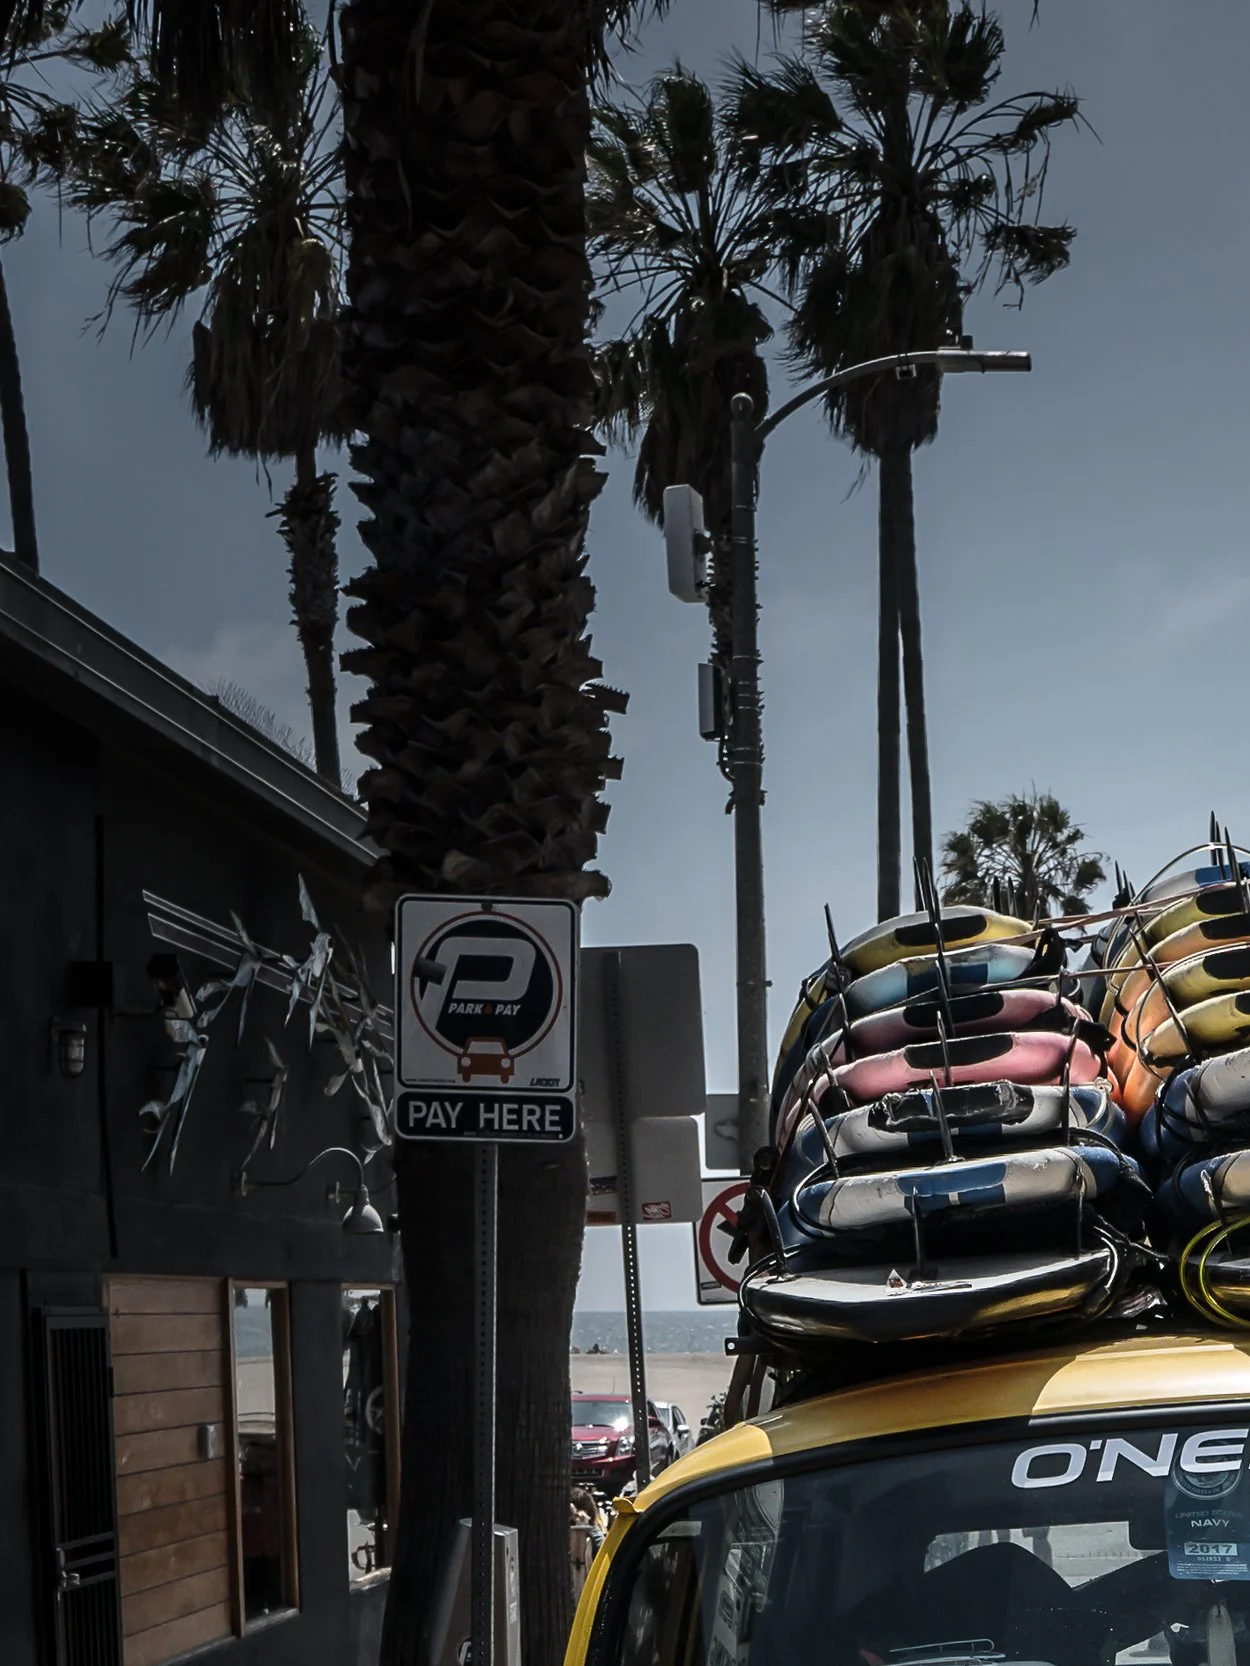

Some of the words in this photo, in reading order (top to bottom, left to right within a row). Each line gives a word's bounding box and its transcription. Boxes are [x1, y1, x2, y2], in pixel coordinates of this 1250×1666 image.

[448, 1002, 485, 1015] PARK
[495, 1004, 522, 1016] PAY
[408, 1100, 464, 1129] PAY
[479, 1103, 562, 1131] HERE
[1190, 1518, 1230, 1528] NAVY
[1188, 1543, 1233, 1554] 2017
